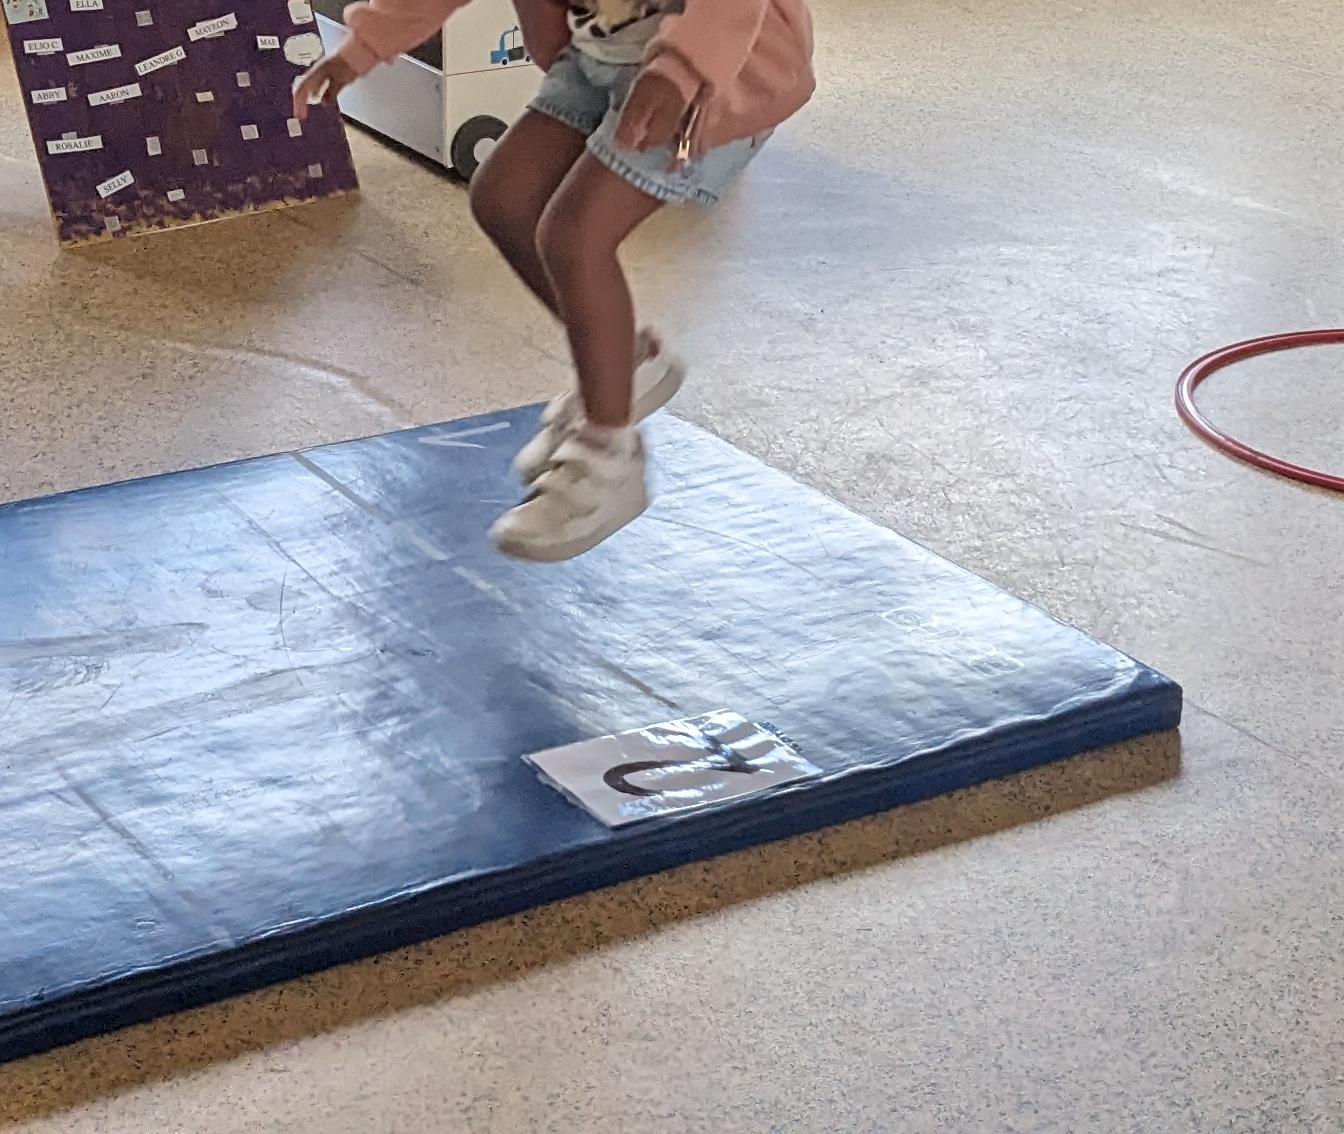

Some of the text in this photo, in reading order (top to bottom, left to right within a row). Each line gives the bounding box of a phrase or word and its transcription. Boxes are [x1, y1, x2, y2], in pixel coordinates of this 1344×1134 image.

[76, 0, 99, 8] ELLA
[195, 18, 230, 36] MAYRON
[28, 41, 49, 51] ELIO
[76, 48, 113, 63] MAXIME
[99, 88, 130, 103] AARON
[55, 139, 94, 151] ROSALIE
[103, 175, 129, 193] SELLY
